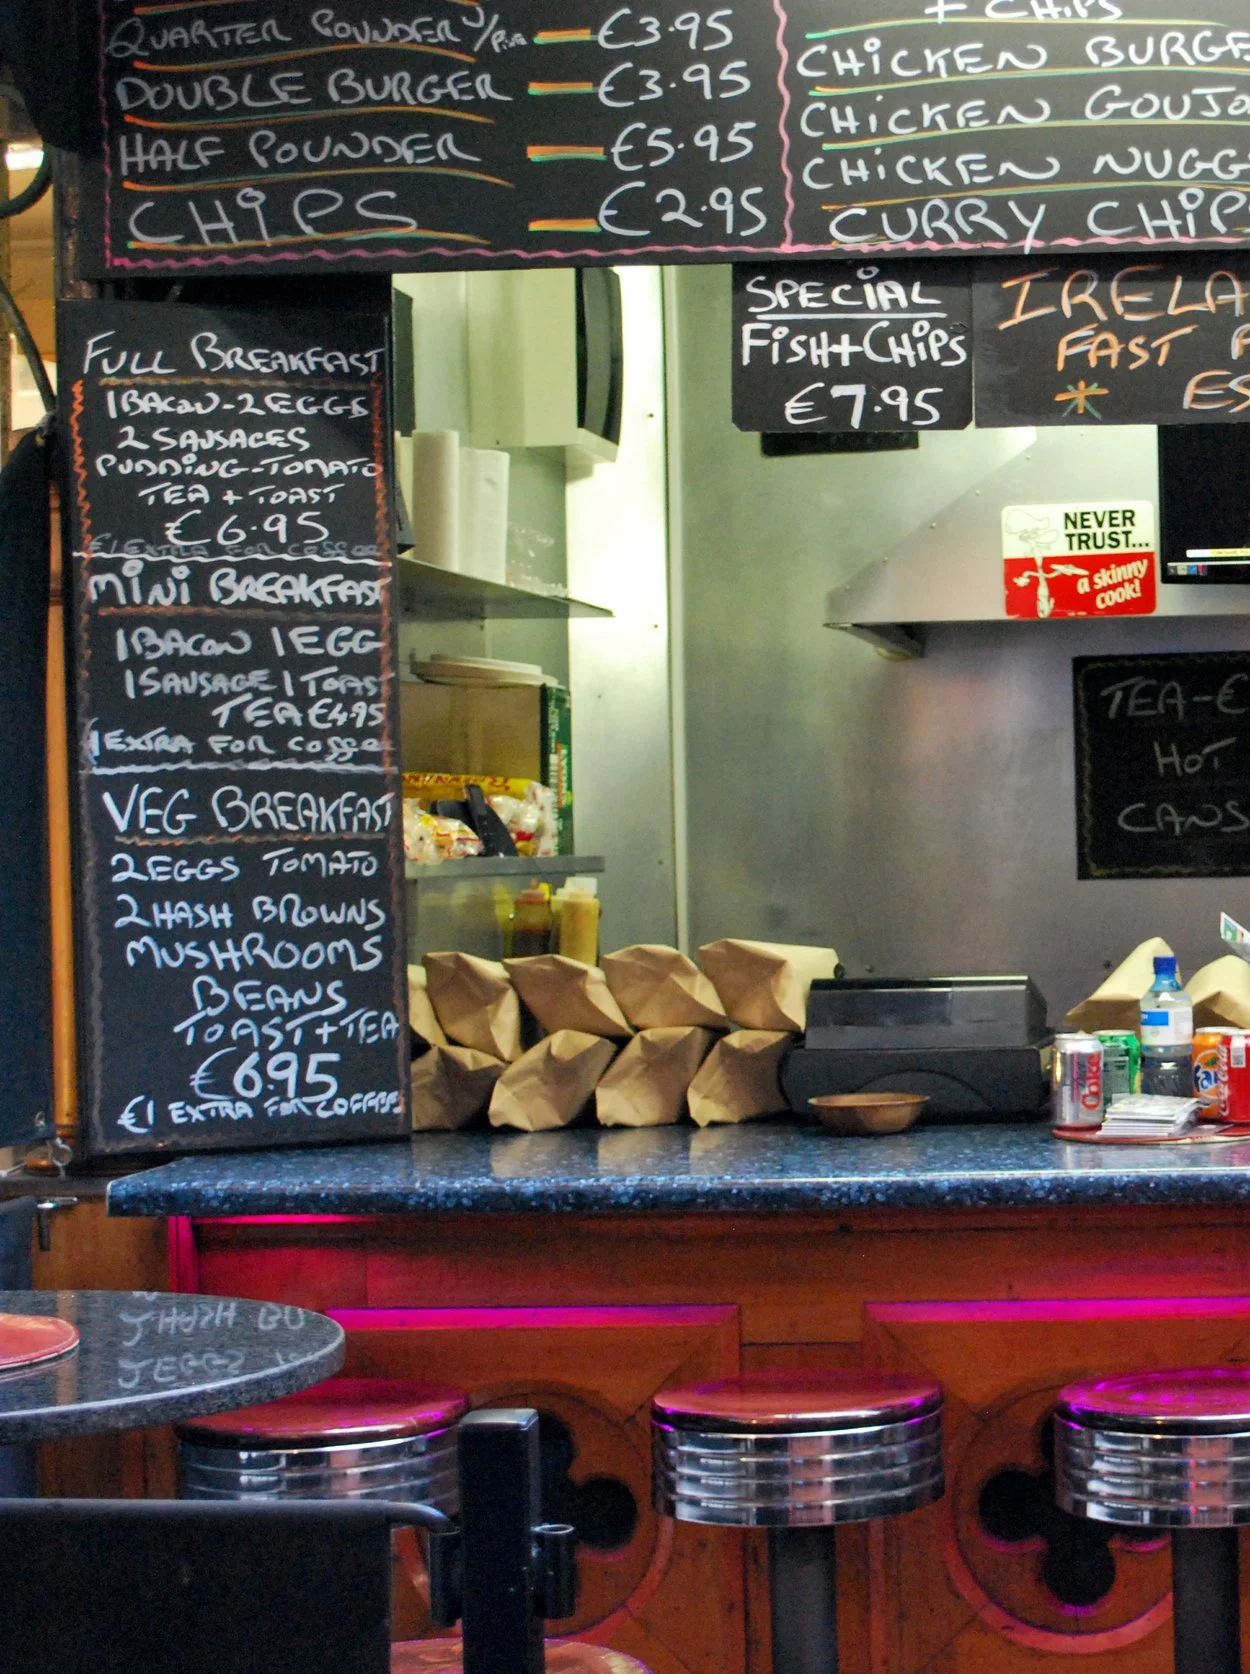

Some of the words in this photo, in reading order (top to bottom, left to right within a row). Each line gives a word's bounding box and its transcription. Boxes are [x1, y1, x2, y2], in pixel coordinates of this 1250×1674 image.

[105, 17, 292, 57] QUARTER
[598, 8, 733, 50] €3.95
[116, 72, 311, 110] DOUBLE
[328, 68, 512, 105] BURGER
[598, 61, 751, 107] €3.95
[120, 133, 225, 175] HALF
[249, 130, 481, 165] POUNDER
[611, 122, 756, 172] €5.95
[599, 181, 767, 236] €2.95
[829, 199, 1046, 255] CURRY
[83, 330, 176, 375] FULL
[190, 332, 386, 375] BREAKFAST
[1057, 324, 1197, 372] FAST
[785, 383, 944, 429] €7.95
[138, 482, 209, 506] TEA
[249, 483, 345, 504] TOAST
[165, 509, 329, 545] €6.95
[1063, 509, 1136, 530] NEVER
[210, 567, 392, 607] BREAKFAST
[1076, 577, 1091, 595] a
[1093, 558, 1149, 590] skinny
[1095, 578, 1142, 609] cook!
[212, 693, 303, 728] TEA
[104, 726, 195, 754] EXTRA
[208, 735, 275, 754] FOR
[1155, 736, 1237, 777] HOT
[103, 784, 197, 835] VEG
[212, 785, 395, 832] BREAKFAST
[1118, 803, 1250, 833] CANS
[263, 847, 378, 878] TOMATO
[253, 893, 386, 931] BROWNS
[126, 932, 382, 972] MUSHROOMS
[193, 975, 347, 1016] BEANS
[189, 1047, 341, 1101] €6.95
[168, 1100, 254, 1124] EXTRA
[264, 1097, 312, 1120] FOR
